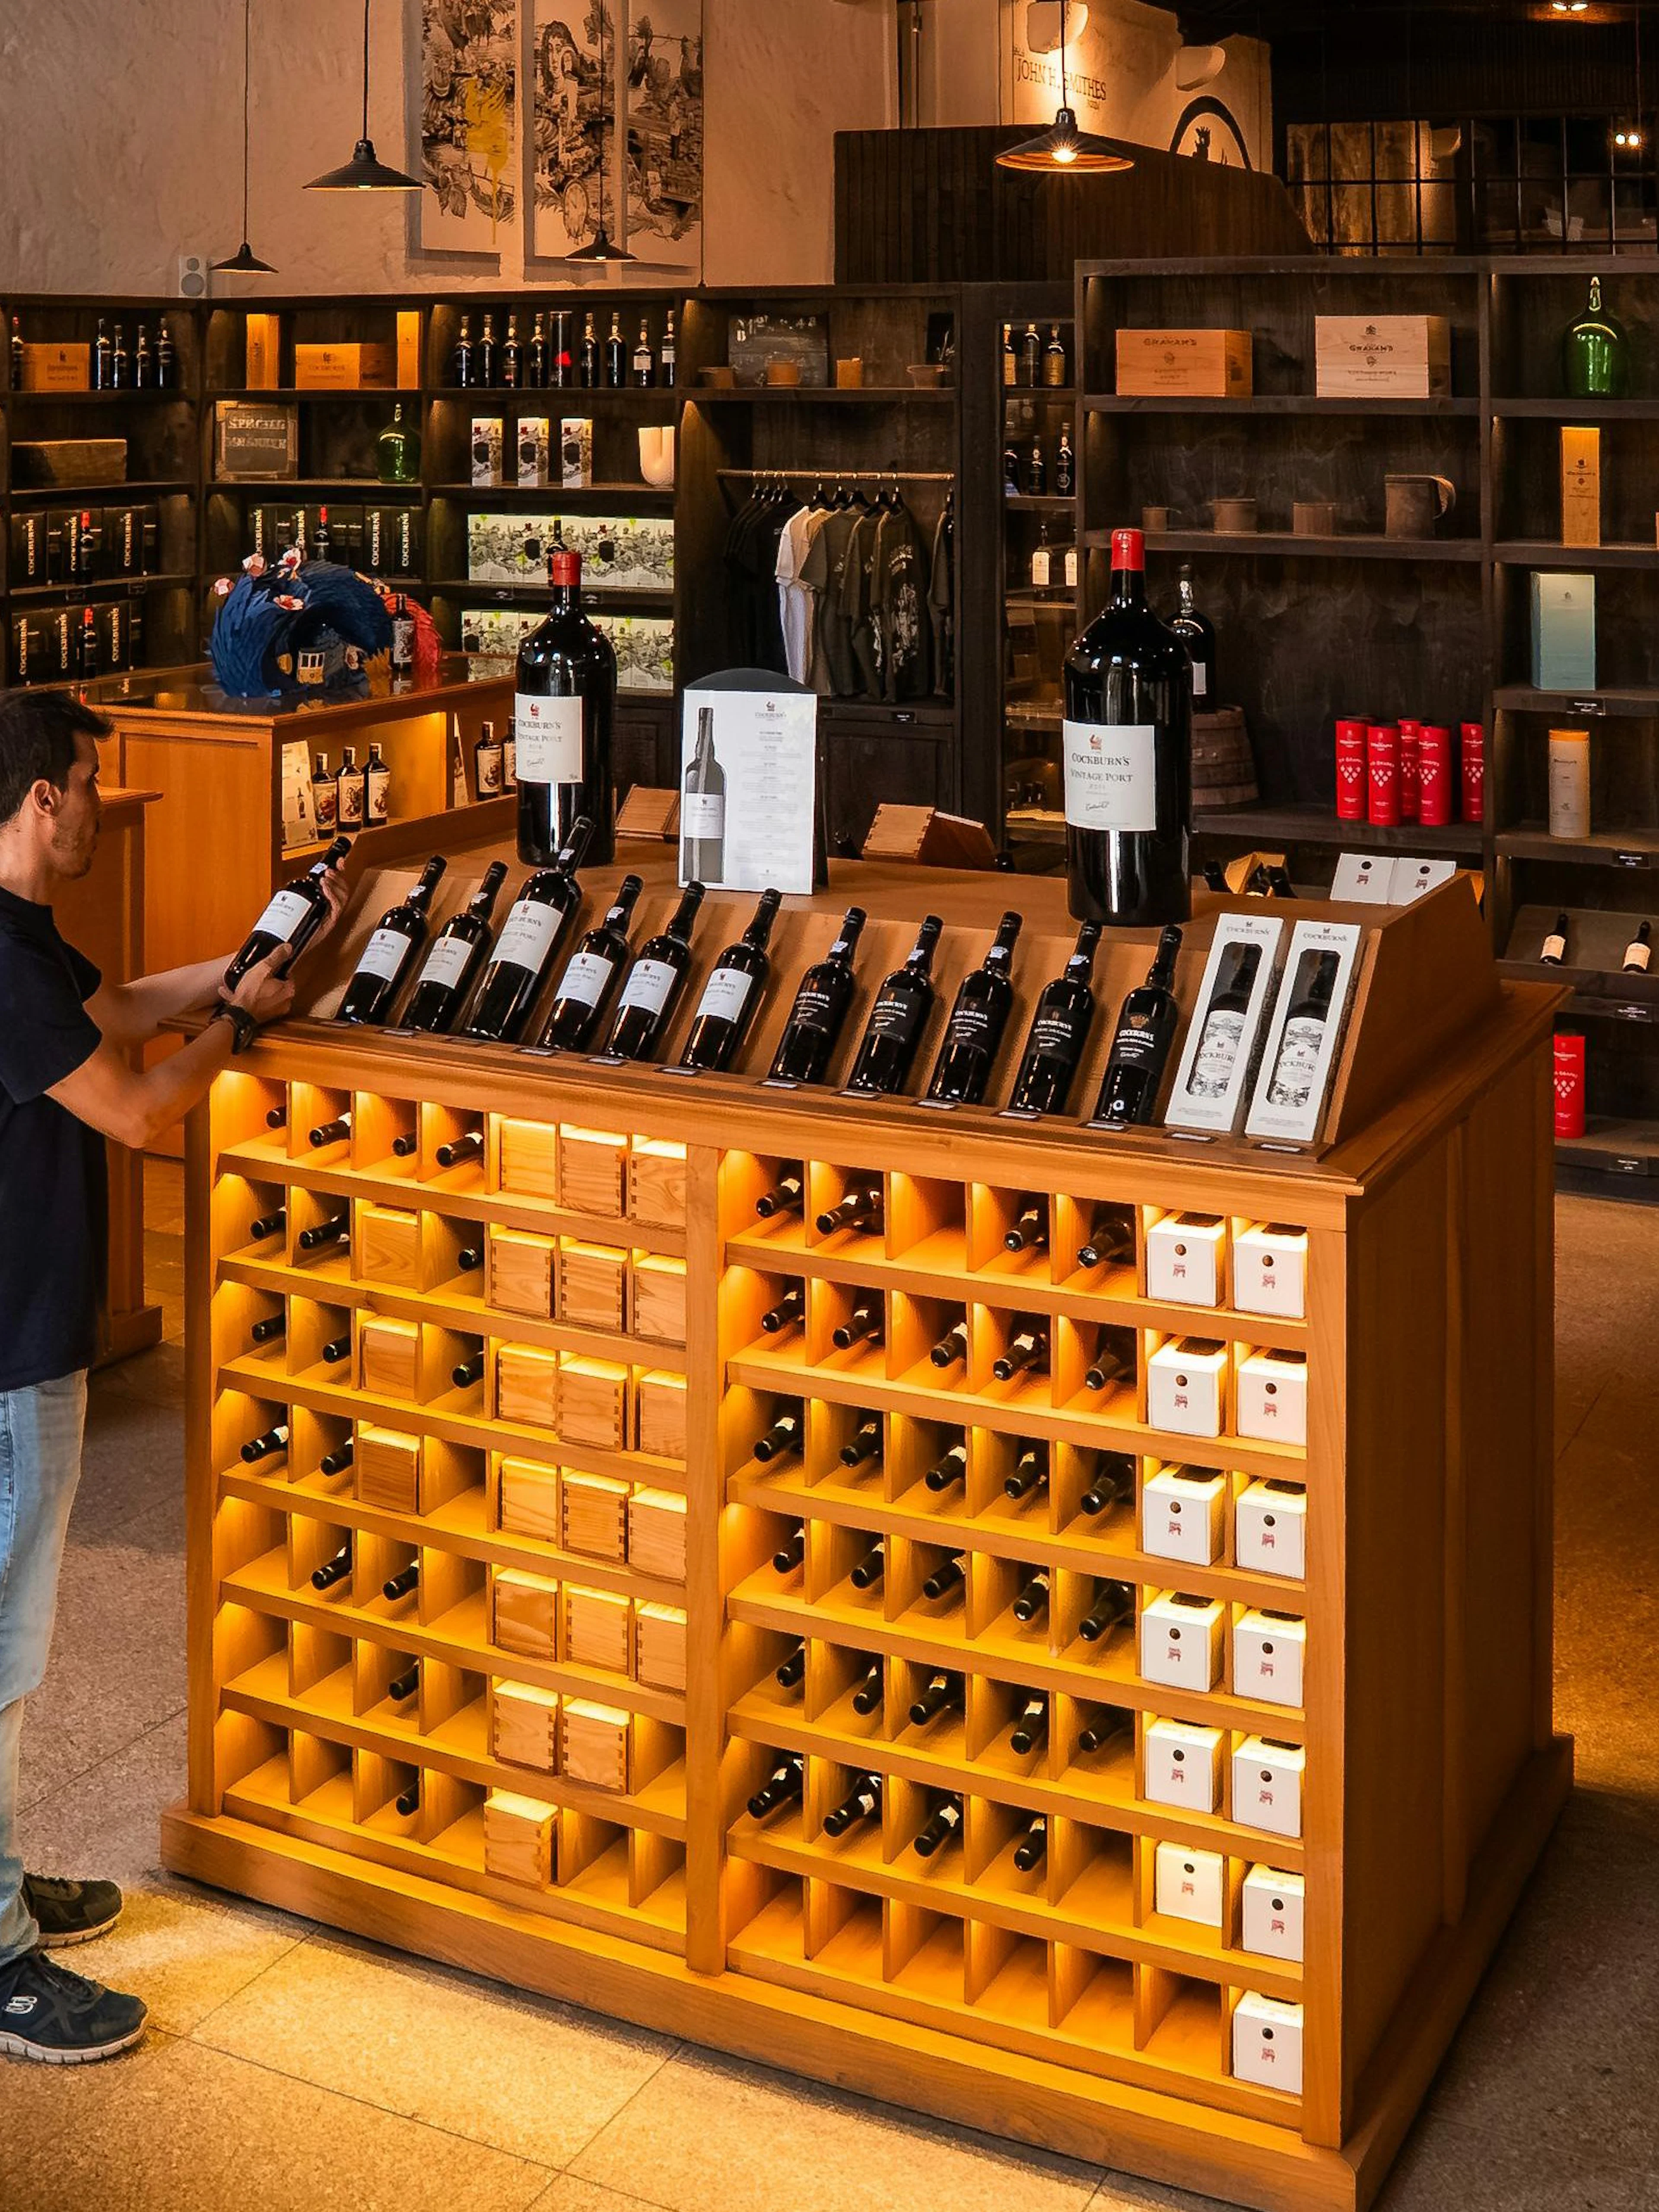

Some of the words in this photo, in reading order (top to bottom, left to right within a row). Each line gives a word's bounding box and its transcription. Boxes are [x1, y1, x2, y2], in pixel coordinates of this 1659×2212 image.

[1017, 58, 1046, 84] JOHN
[1063, 71, 1106, 100] SMITHES
[1071, 753, 1131, 766] COCKBURN'S
[1071, 768, 1103, 782] VINTAGE
[1105, 772, 1134, 782] PORT
